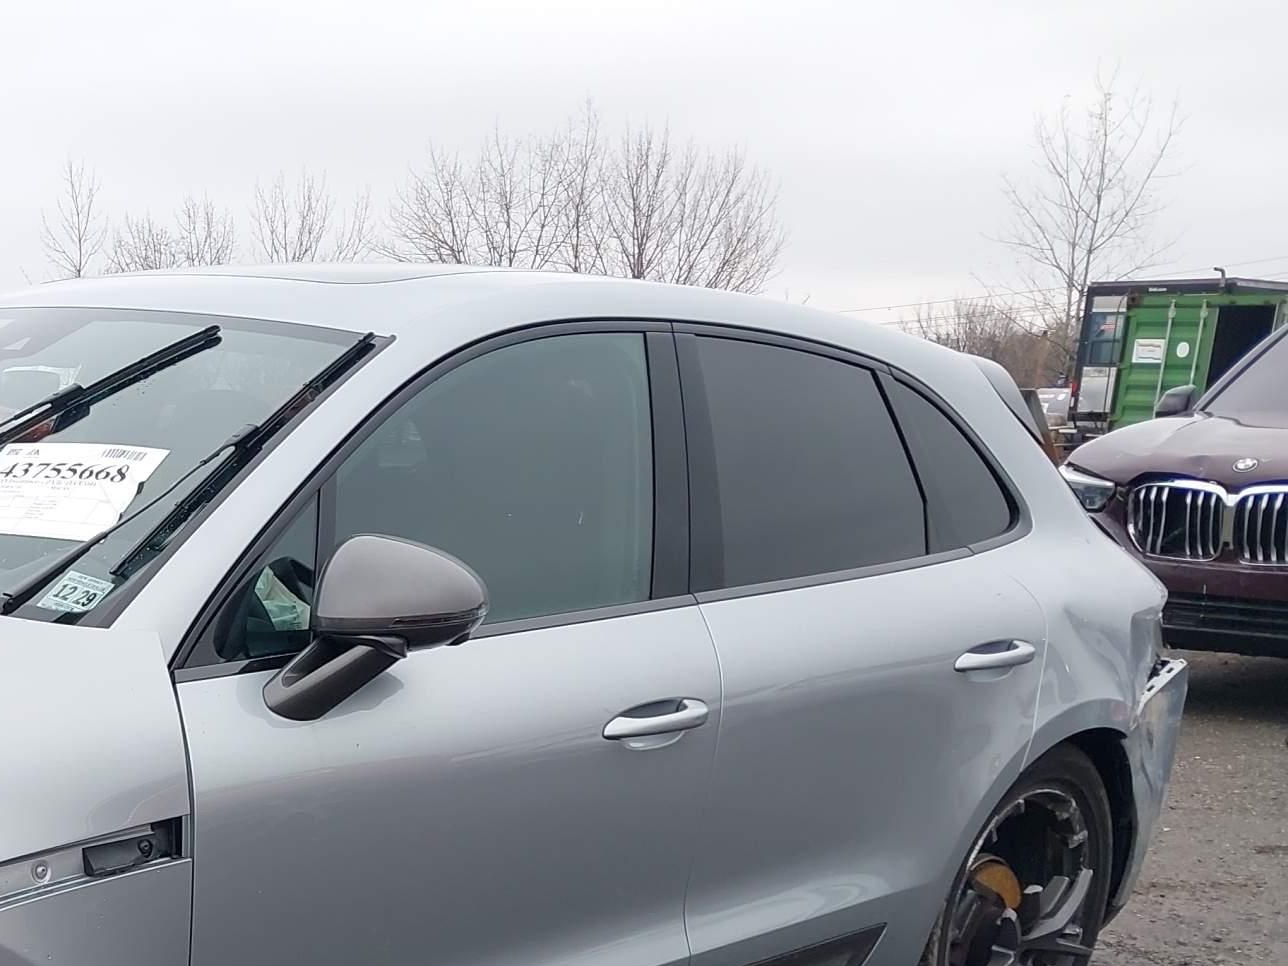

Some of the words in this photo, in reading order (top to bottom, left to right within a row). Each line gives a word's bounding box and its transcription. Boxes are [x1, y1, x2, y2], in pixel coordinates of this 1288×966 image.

[0, 462, 130, 483] 43755668
[53, 583, 78, 600] 12
[73, 590, 97, 607] 29
